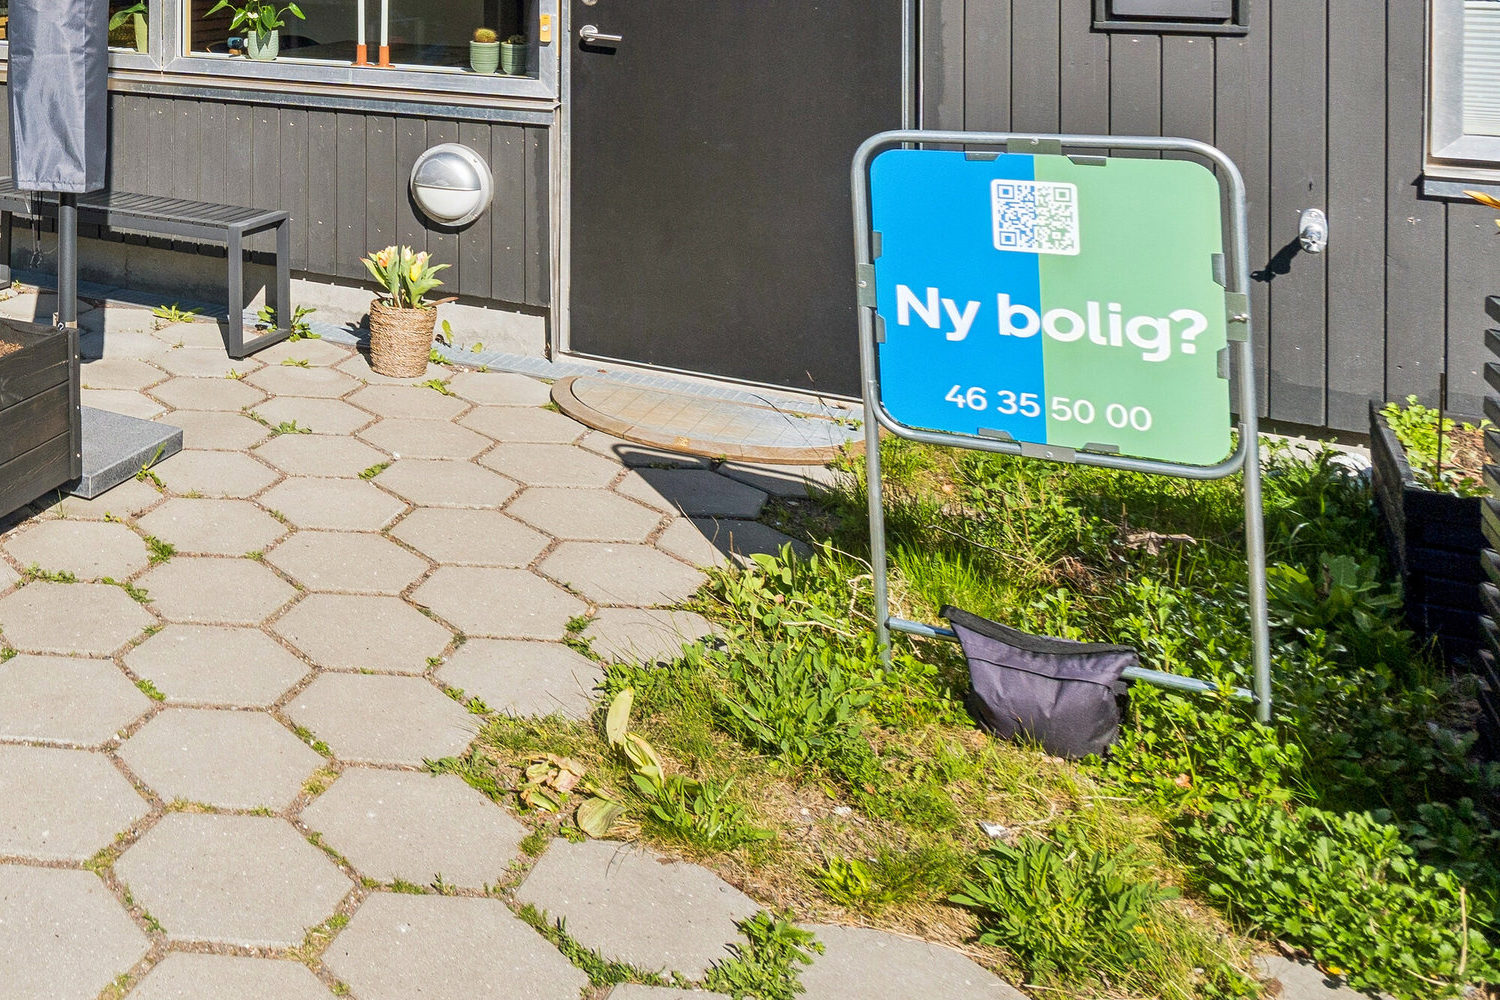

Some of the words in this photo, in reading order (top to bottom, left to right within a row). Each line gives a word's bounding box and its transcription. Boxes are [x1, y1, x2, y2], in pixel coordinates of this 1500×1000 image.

[896, 284, 981, 342] Ny
[997, 293, 1209, 362] bolig?
[945, 384, 988, 411] 46
[997, 390, 1041, 418] 35
[1050, 396, 1096, 424] 50
[1105, 402, 1153, 432] 00
